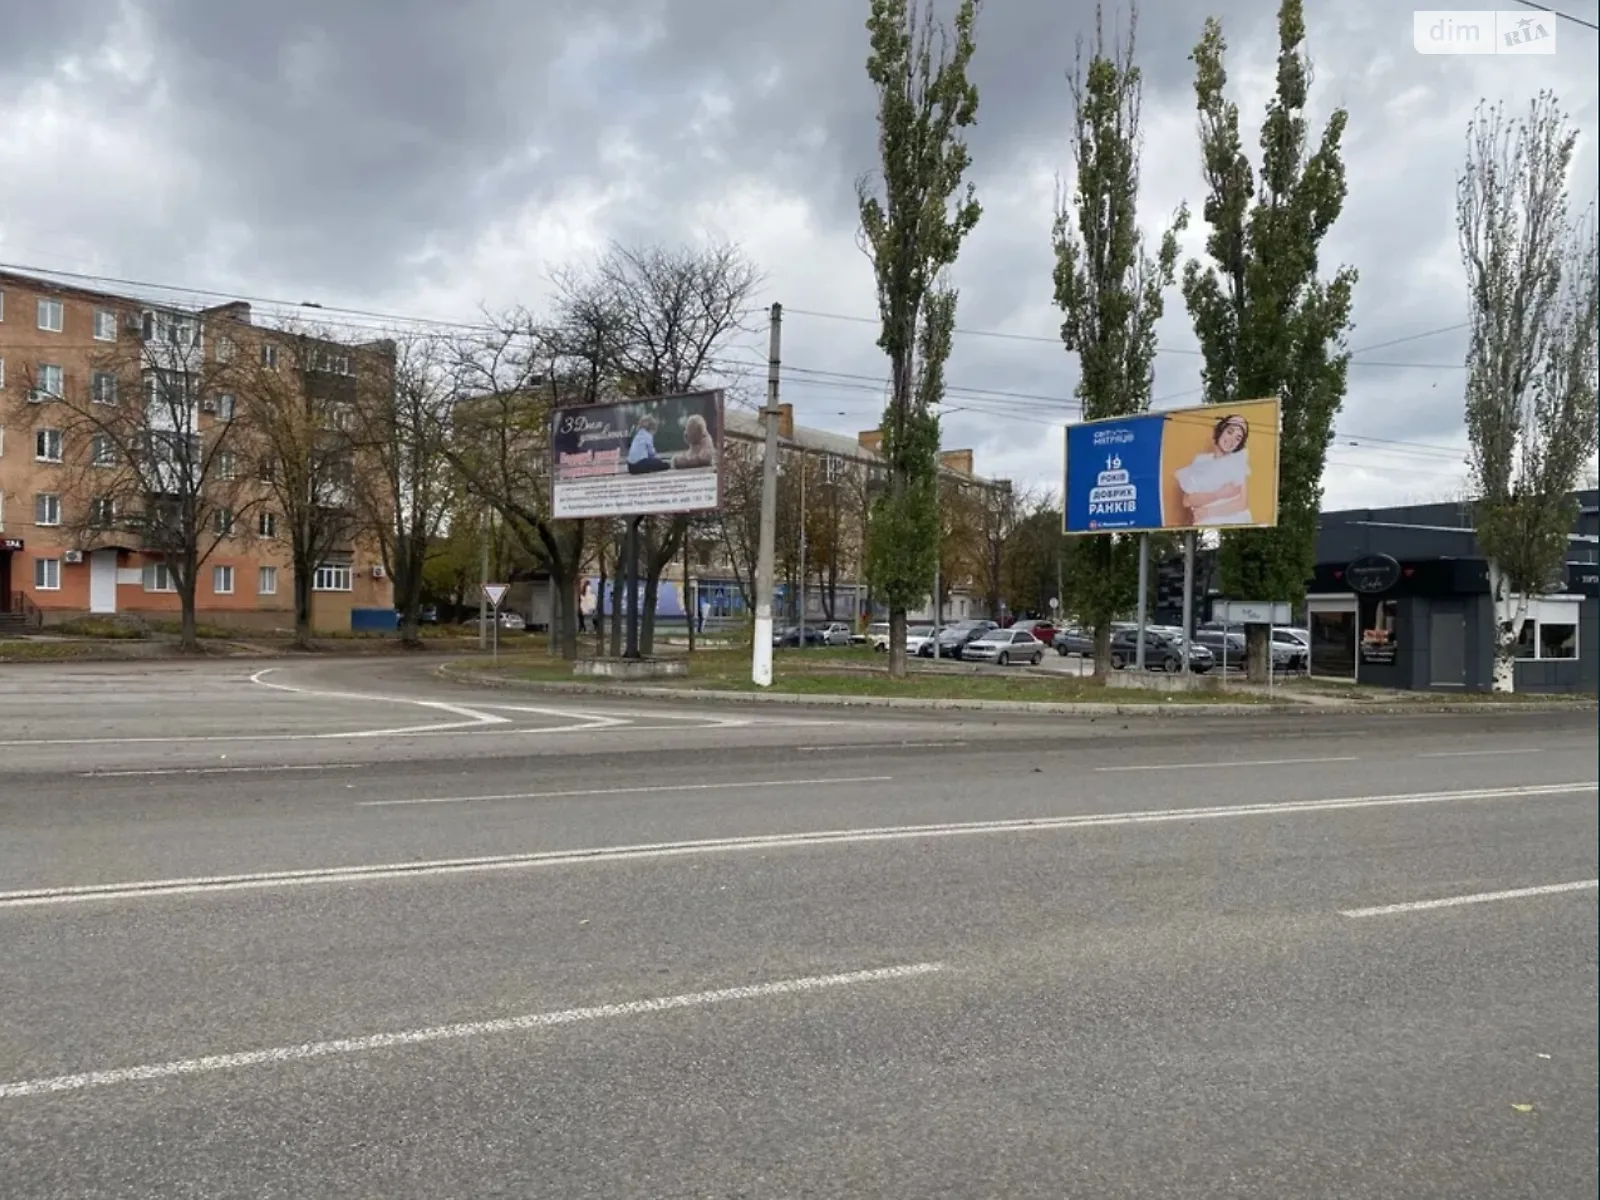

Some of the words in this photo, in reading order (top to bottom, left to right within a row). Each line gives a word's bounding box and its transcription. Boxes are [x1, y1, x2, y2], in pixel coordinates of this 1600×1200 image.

[1105, 456, 1121, 470] 19
[1101, 473, 1126, 482] РОКІВ
[1093, 488, 1133, 501] ДОБРИХ
[1089, 501, 1136, 515] РАНКІВ
